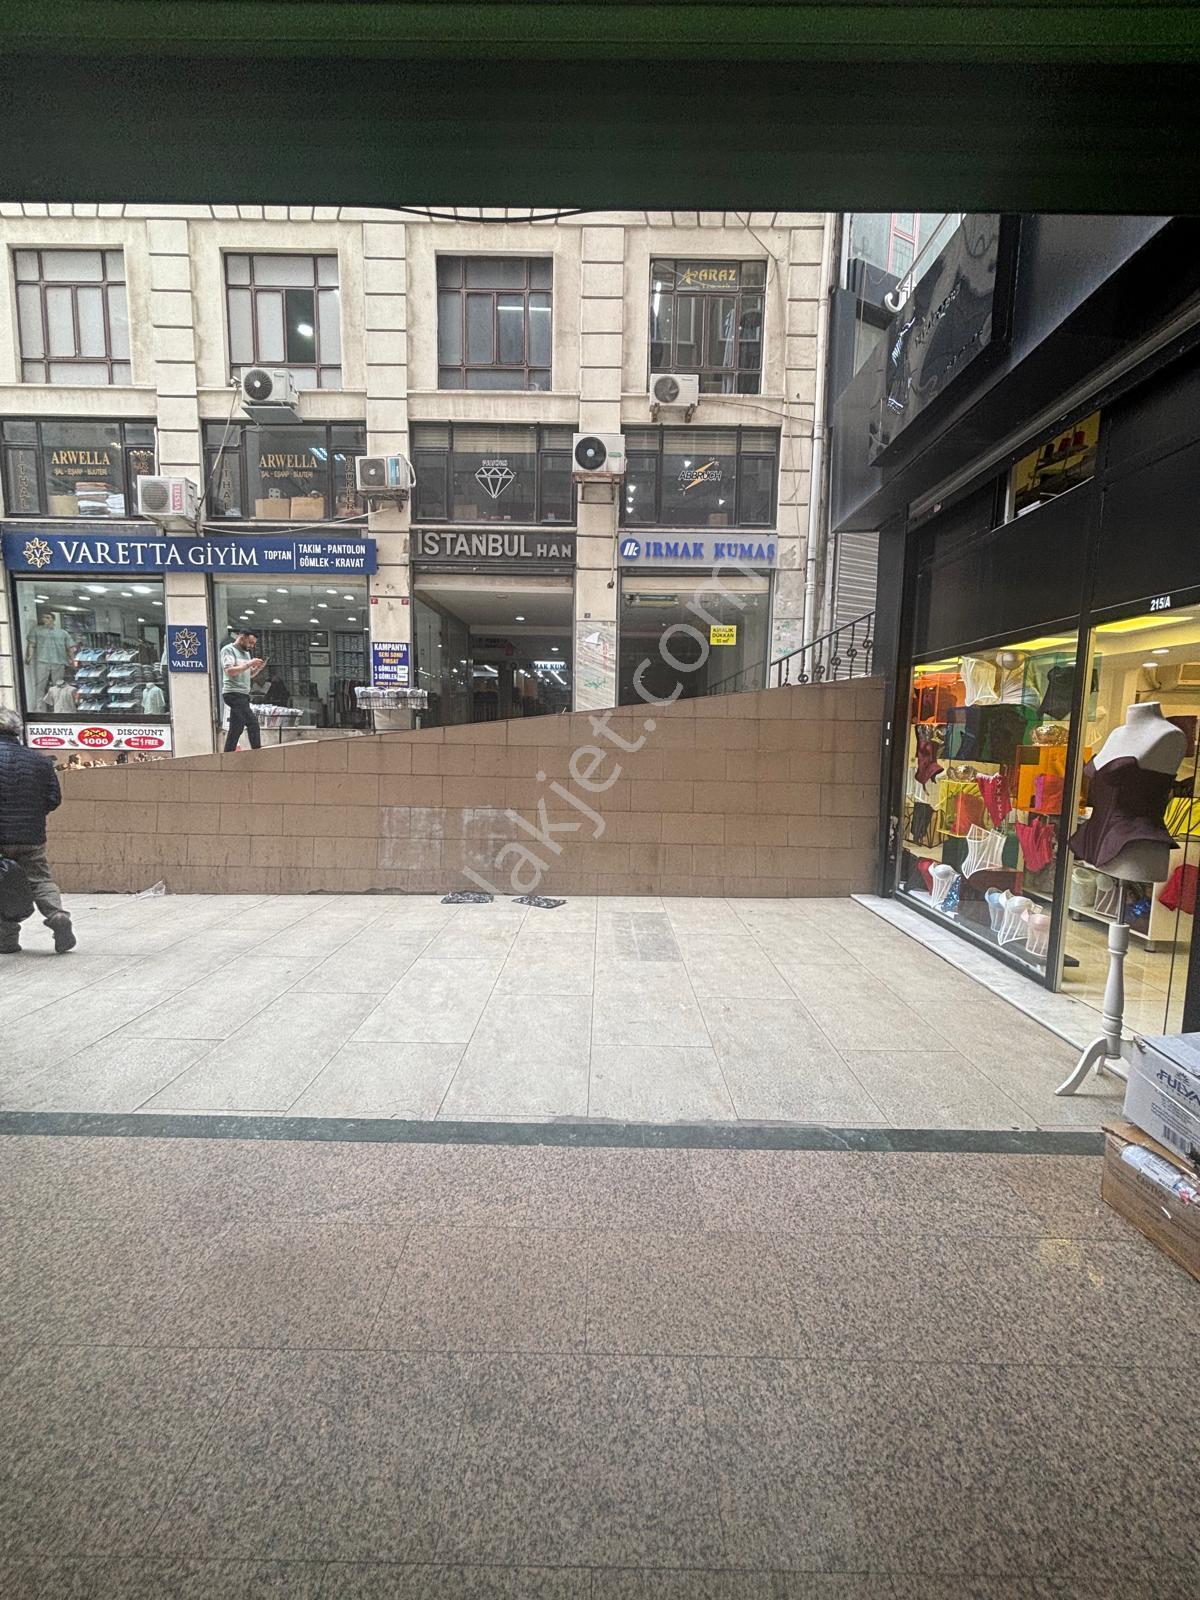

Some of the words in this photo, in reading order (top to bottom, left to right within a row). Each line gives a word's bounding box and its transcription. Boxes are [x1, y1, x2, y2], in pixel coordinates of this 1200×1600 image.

[698, 268, 736, 281] ARAZ
[51, 450, 110, 465] ARWELLA
[259, 454, 318, 468] ARWELLA
[298, 544, 322, 554] TAKIM
[327, 544, 366, 555] PANTOLON
[417, 529, 533, 558] İSTANBUL
[536, 544, 572, 558] HAN
[58, 541, 185, 566] VARETTA
[187, 542, 259, 566] GİYİM
[263, 550, 292, 561] TOPTAN
[714, 542, 775, 565] KUMAŞ
[299, 555, 330, 567] GÖMLEK
[335, 557, 365, 568] KRAVAT
[1150, 595, 1171, 612] 215/A
[374, 643, 407, 651] KAMPANYA
[171, 660, 204, 668] VARETTA
[29, 727, 75, 736] KAMPANYA
[117, 728, 164, 737] DISCOUNT
[83, 737, 109, 745] 1000
